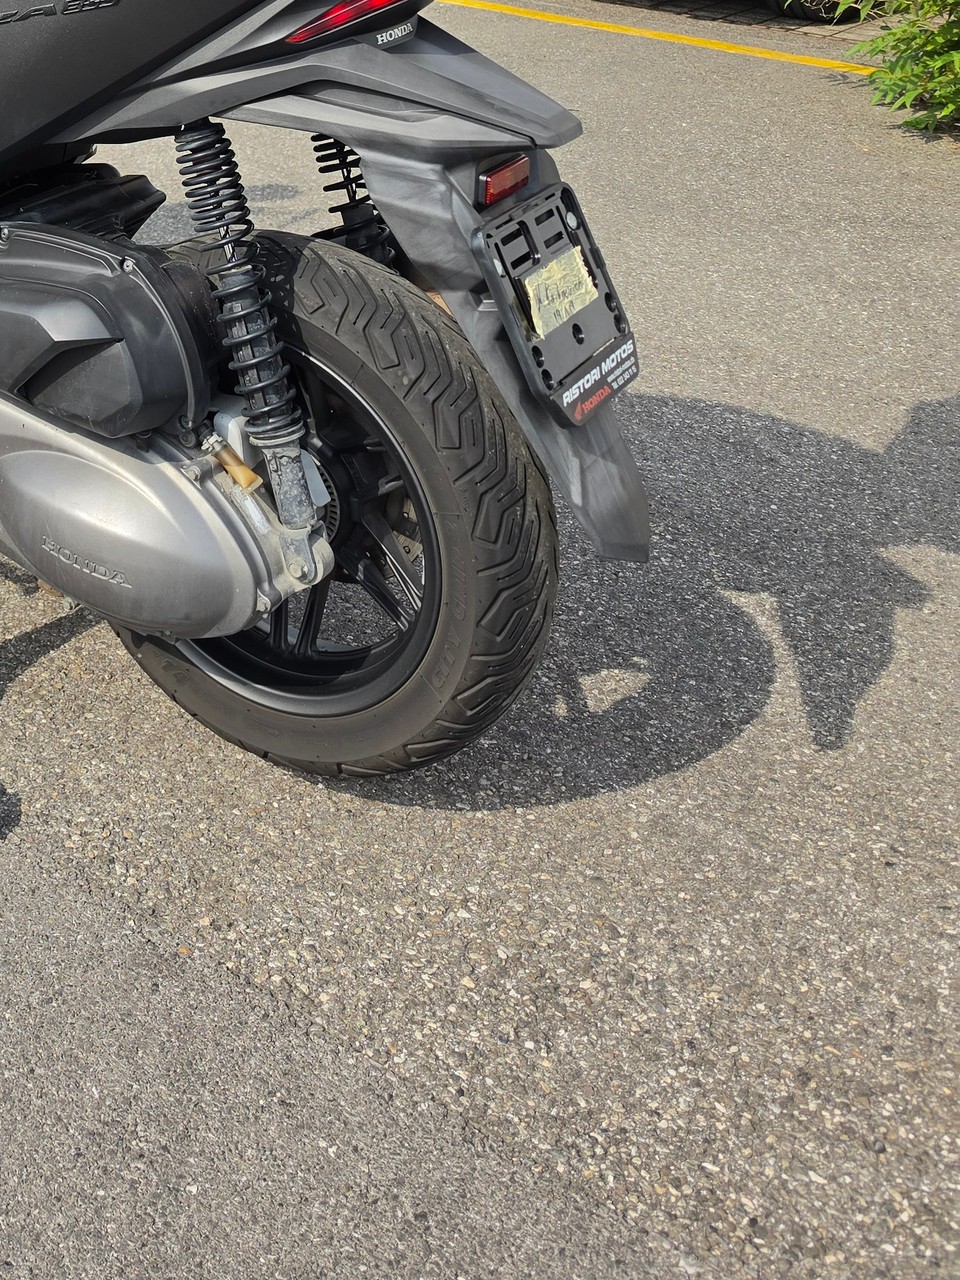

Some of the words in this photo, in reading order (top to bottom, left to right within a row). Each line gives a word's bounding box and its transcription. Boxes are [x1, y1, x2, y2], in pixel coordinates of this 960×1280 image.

[376, 22, 414, 45] HONDA
[562, 366, 601, 407] RISTORI
[601, 339, 634, 375] MOTOS
[581, 385, 612, 413] HONDA
[42, 535, 132, 588] HONDA
